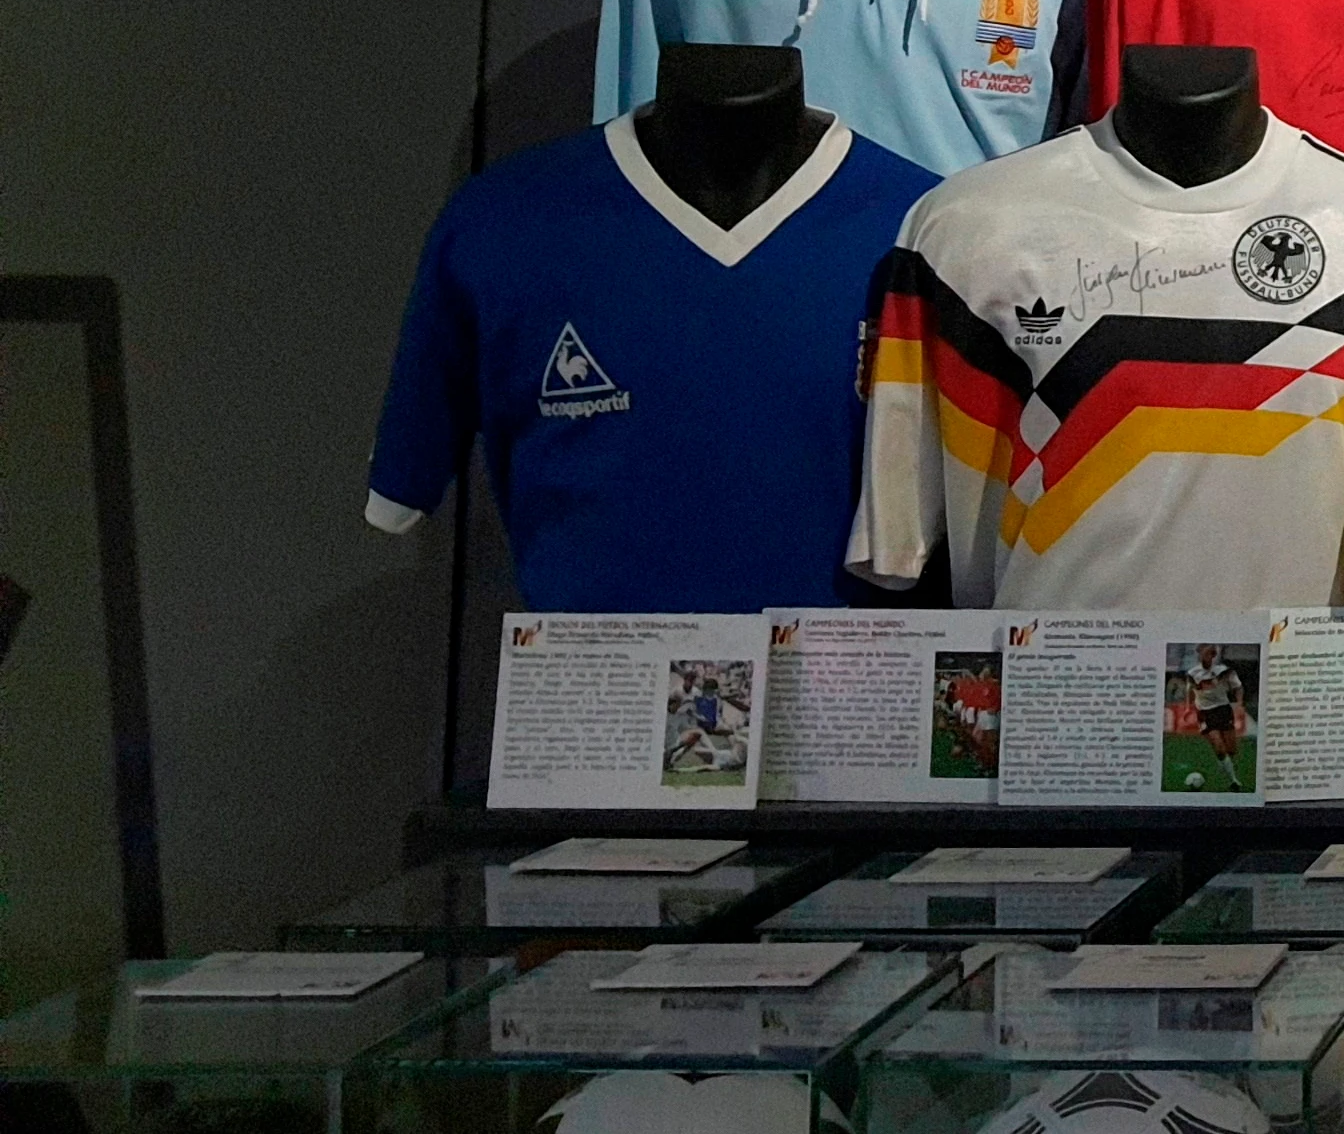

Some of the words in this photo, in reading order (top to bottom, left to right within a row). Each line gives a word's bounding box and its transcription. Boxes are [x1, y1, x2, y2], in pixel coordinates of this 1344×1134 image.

[961, 78, 983, 89] DEL
[986, 82, 1031, 94] MUNDO
[1247, 218, 1321, 253] DEUTSCHER
[1014, 335, 1062, 346] adidas
[1044, 621, 1094, 629] CAMPEONES
[1096, 621, 1111, 629] DEL
[1112, 620, 1146, 629] MUNDO
[1295, 616, 1344, 626] CAMPEONES
